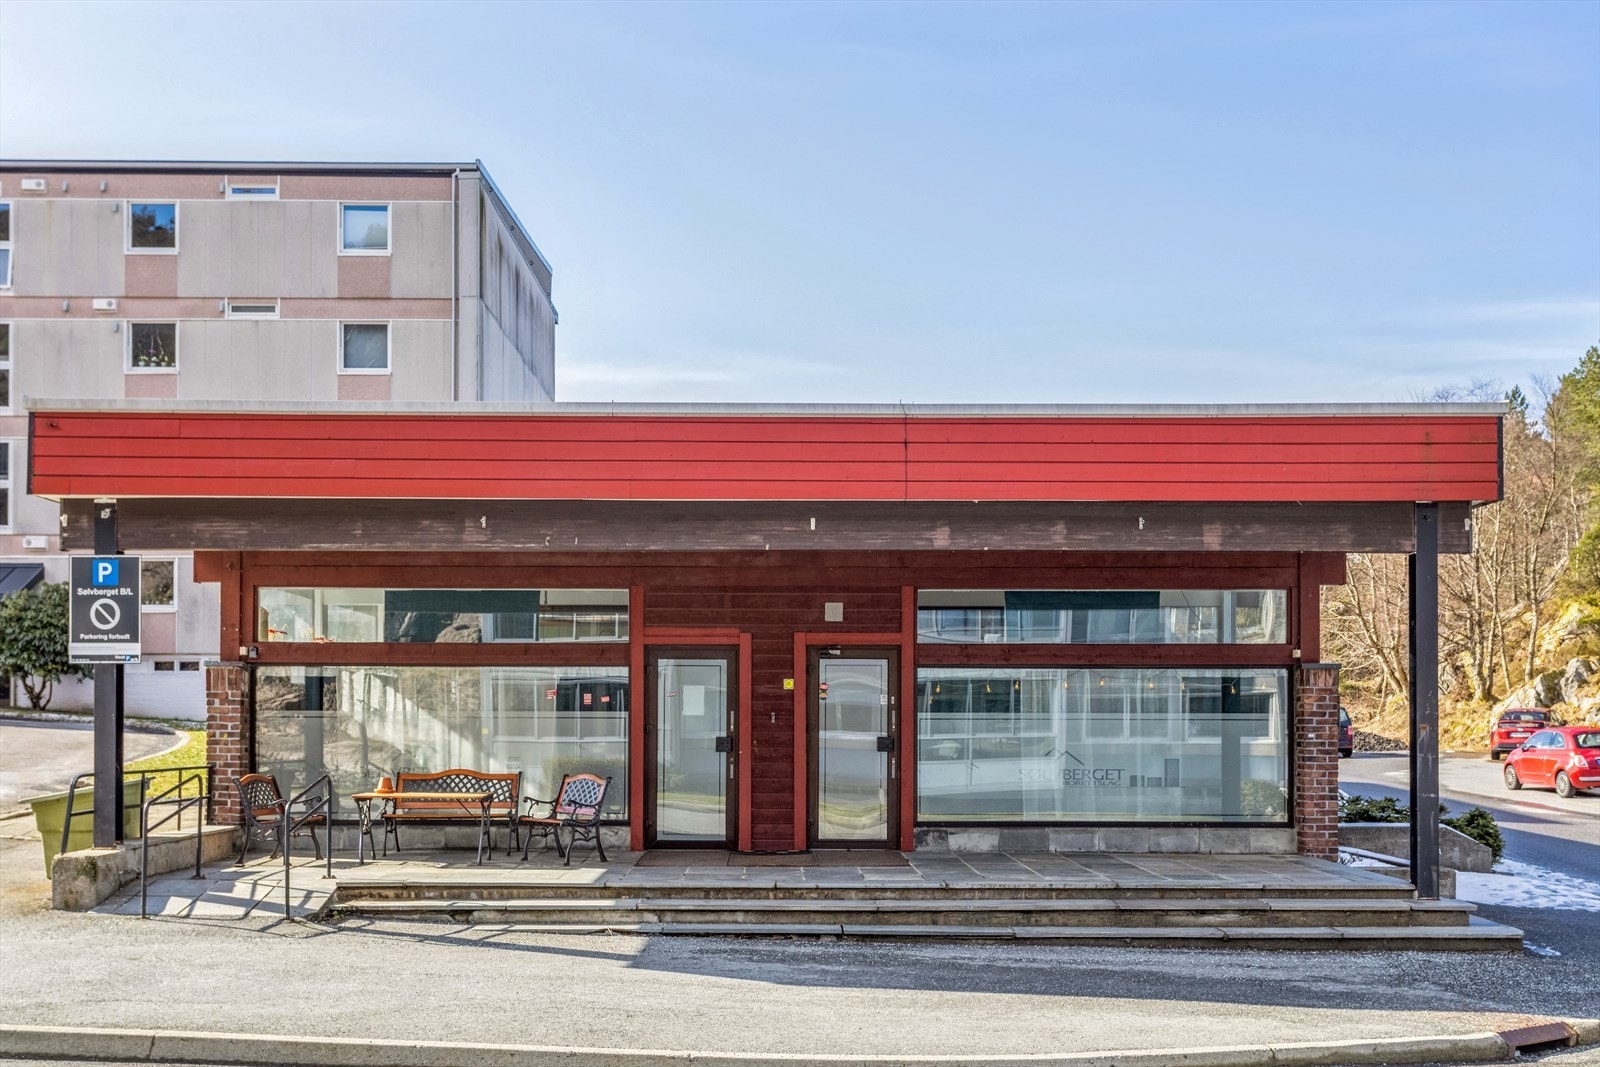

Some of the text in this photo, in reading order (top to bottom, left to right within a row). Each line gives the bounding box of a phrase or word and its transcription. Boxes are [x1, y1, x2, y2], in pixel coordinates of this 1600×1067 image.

[98, 562, 113, 583] P
[120, 587, 134, 596] B/L
[80, 633, 108, 641] Parkering
